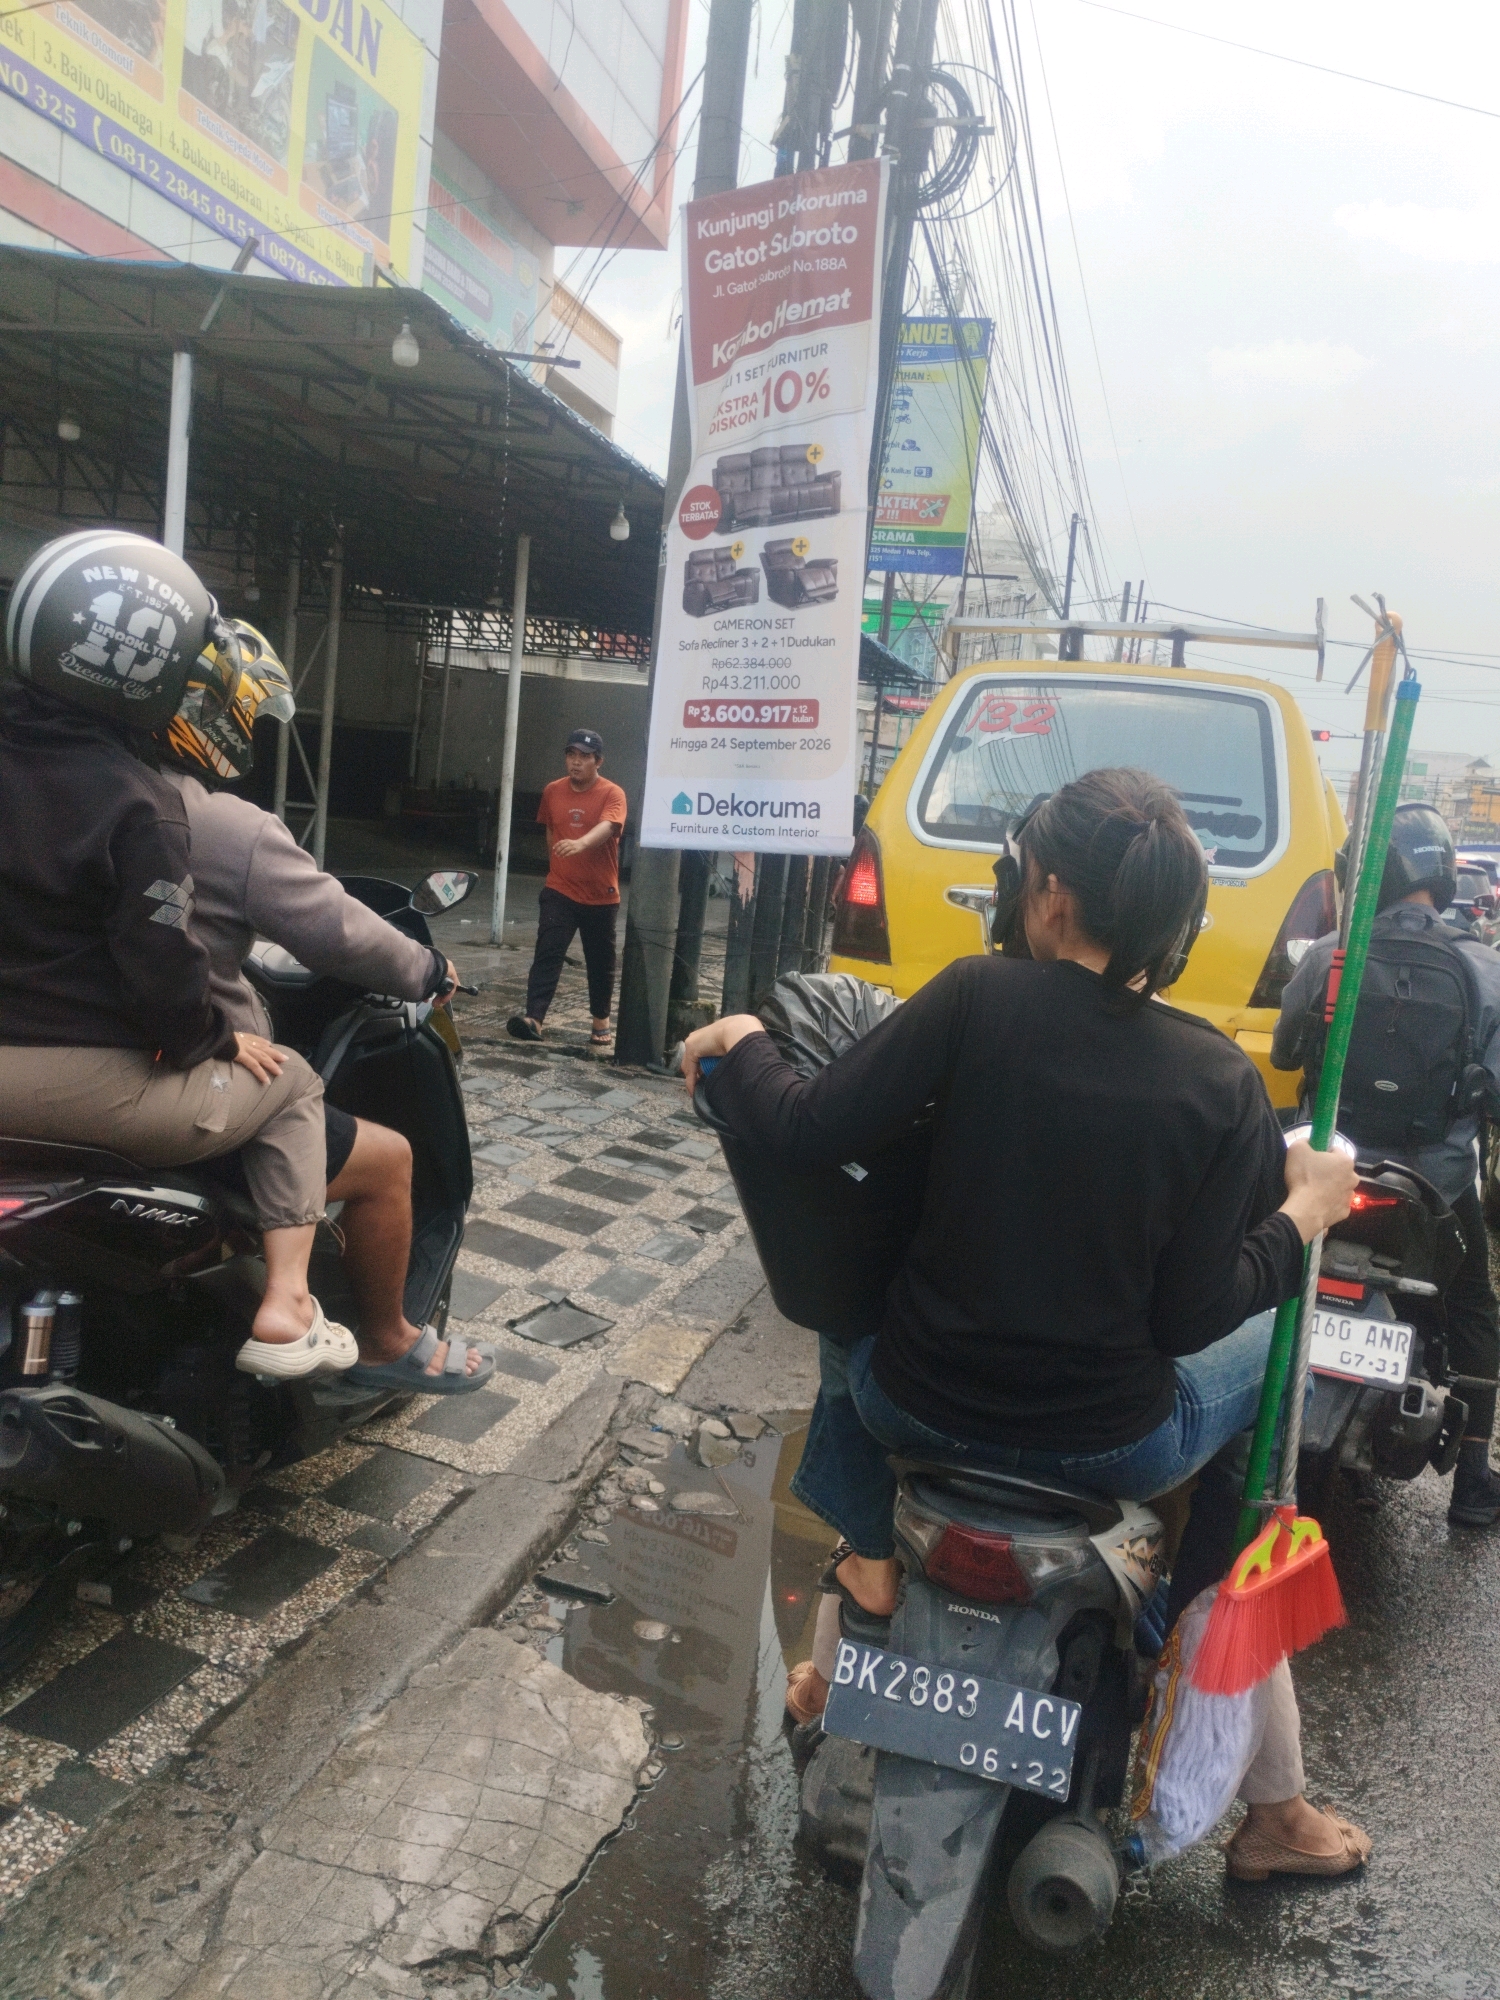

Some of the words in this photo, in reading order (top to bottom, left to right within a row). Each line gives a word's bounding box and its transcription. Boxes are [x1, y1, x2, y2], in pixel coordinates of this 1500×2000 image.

[55, 4, 90, 39] Teknik
[91, 31, 135, 74] Otomotif
[61, 53, 92, 94] Baju
[95, 78, 153, 136] Olahraga
[182, 136, 212, 173] Buku
[213, 162, 262, 212] Pelajaran
[196, 109, 223, 143] Teknik
[35, 84, 77, 129] 325
[110, 135, 160, 182] 0812
[166, 171, 211, 215] 2845
[270, 242, 307, 278] 0878
[697, 204, 774, 240] Kunjungi
[778, 188, 867, 219] Dekoruma
[704, 241, 768, 274] Gatot
[769, 225, 858, 257] Subroto
[727, 278, 758, 297] Gatot
[793, 257, 847, 273] No.188A
[745, 364, 766, 383] SET
[766, 342, 829, 373] FURNITUR
[906, 348, 928, 359] Kerja
[761, 367, 831, 419] 10%
[708, 408, 758, 436] DISKON
[681, 510, 719, 523] TERBATAS
[690, 501, 711, 512] STOK
[82, 566, 139, 583] NEW
[147, 574, 194, 624] YORK
[713, 618, 772, 631] CAMERON
[774, 617, 796, 630] SET
[91, 621, 170, 660] BROOKLYN
[678, 638, 700, 651] Sofa
[701, 637, 740, 650] Recliner
[742, 637, 749, 649] 3
[761, 637, 769, 649] 2
[787, 636, 836, 648] Dudukan
[58, 651, 118, 687] Dream
[702, 674, 801, 693] Rp43.211.000
[792, 714, 814, 724] bulan
[670, 737, 708, 752] Hingga
[711, 737, 727, 750] 24
[729, 737, 797, 752] September
[799, 738, 832, 751] 2026
[697, 791, 821, 819] Dekoruma
[670, 822, 719, 835] Furniture
[722, 824, 730, 836] &
[732, 824, 775, 837] Custom
[778, 825, 820, 838] Interior
[1412, 845, 1447, 855] HONDA
[110, 1198, 199, 1228] NMAX
[1322, 1294, 1355, 1307] HONDA
[1365, 1324, 1409, 1355] ANR
[947, 1603, 1001, 1625] HONDA
[1003, 1691, 1080, 1747] ACV
